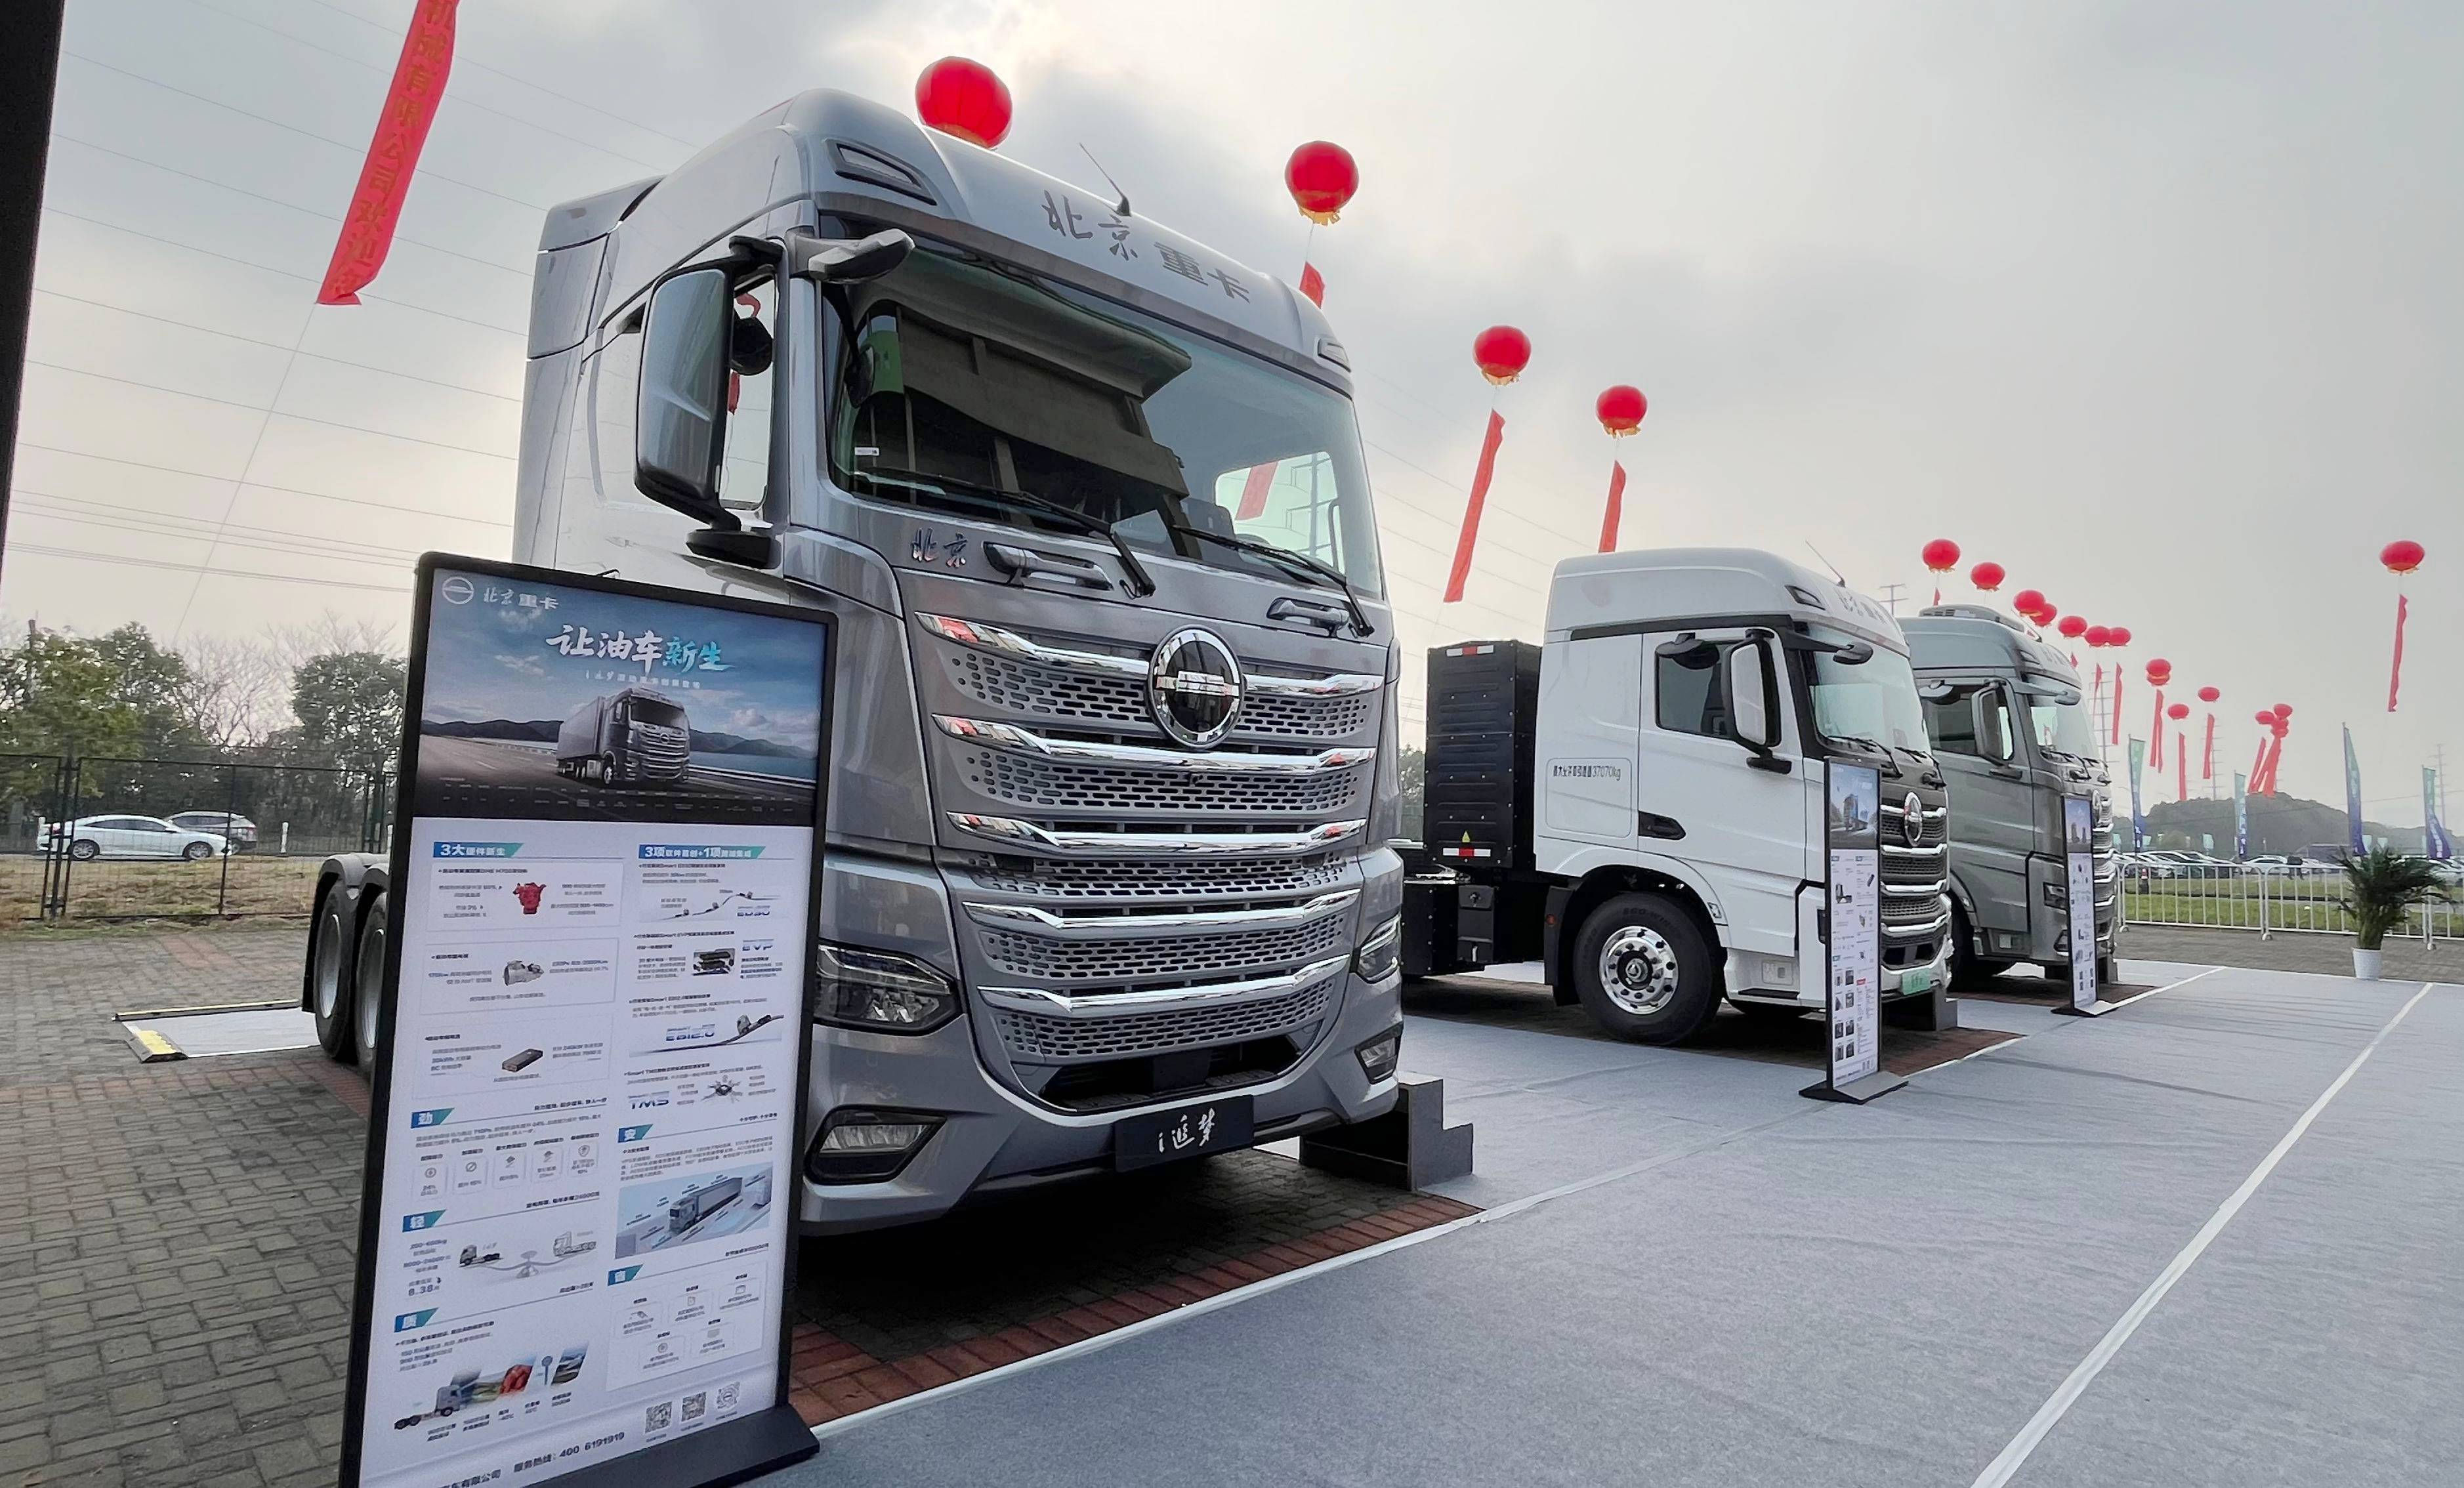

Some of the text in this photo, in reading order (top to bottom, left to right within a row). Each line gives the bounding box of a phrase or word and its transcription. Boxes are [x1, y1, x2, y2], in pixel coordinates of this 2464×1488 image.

[1041, 188, 1251, 304] 北京重卡
[909, 527, 968, 569] 北京
[483, 587, 559, 610] 北京重卡
[545, 624, 736, 677] 让油车新生
[559, 1445, 580, 1457] 400
